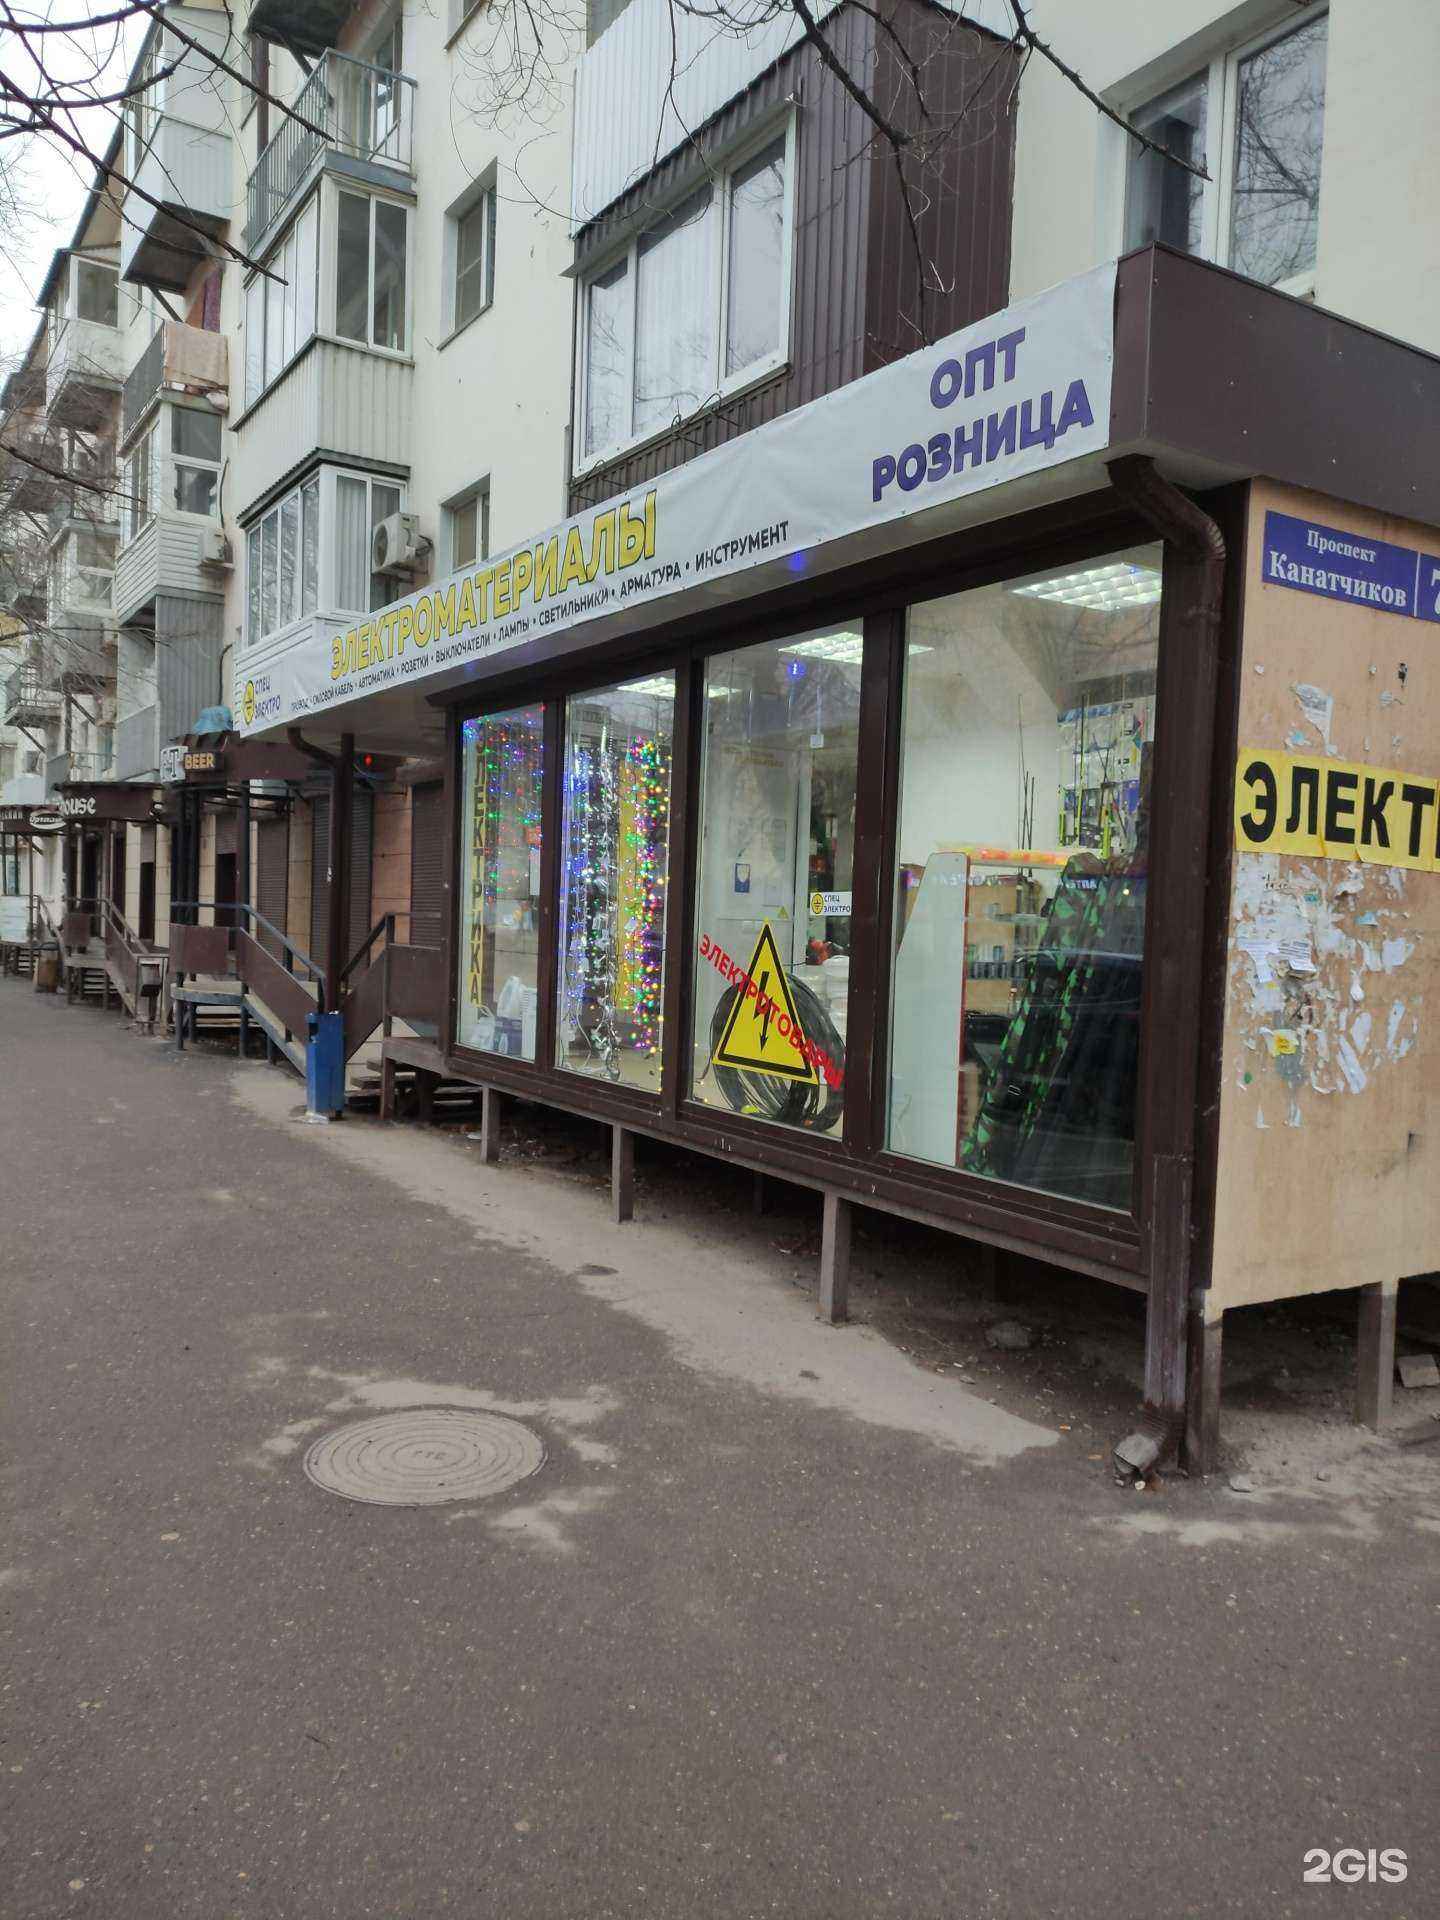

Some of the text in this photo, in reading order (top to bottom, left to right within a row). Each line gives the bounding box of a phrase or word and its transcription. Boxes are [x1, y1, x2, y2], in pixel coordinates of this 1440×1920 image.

[929, 326, 1026, 409] ОПТ
[872, 378, 1095, 502] РОЗНИЦА
[1306, 528, 1377, 563] Проспект
[330, 488, 657, 681] ЭЛЕКТРОМАТЕРИАЛЫ
[1268, 550, 1407, 607] Канатчиков
[334, 681, 354, 698] КАБЕЛЬ
[358, 667, 396, 690] АВТОМАТИКА
[400, 652, 429, 674] РОЗЕТКИ
[435, 633, 491, 664] ВЫКЛЮЧАТЕЛИ
[498, 618, 530, 642] ЛАМПЫ
[538, 588, 609, 626] СВЕТИЛЬНИКИ
[619, 561, 682, 599] АРМАТУРА
[694, 520, 789, 573] ИНСТРУМЕНТ
[254, 675, 271, 695] СПЕЦ
[184, 751, 216, 770] BEER
[1240, 761, 1440, 860] ЭЛЕКТ
[823, 894, 840, 903] СПЕЦ
[823, 905, 851, 913] ЭЛЕКТРО
